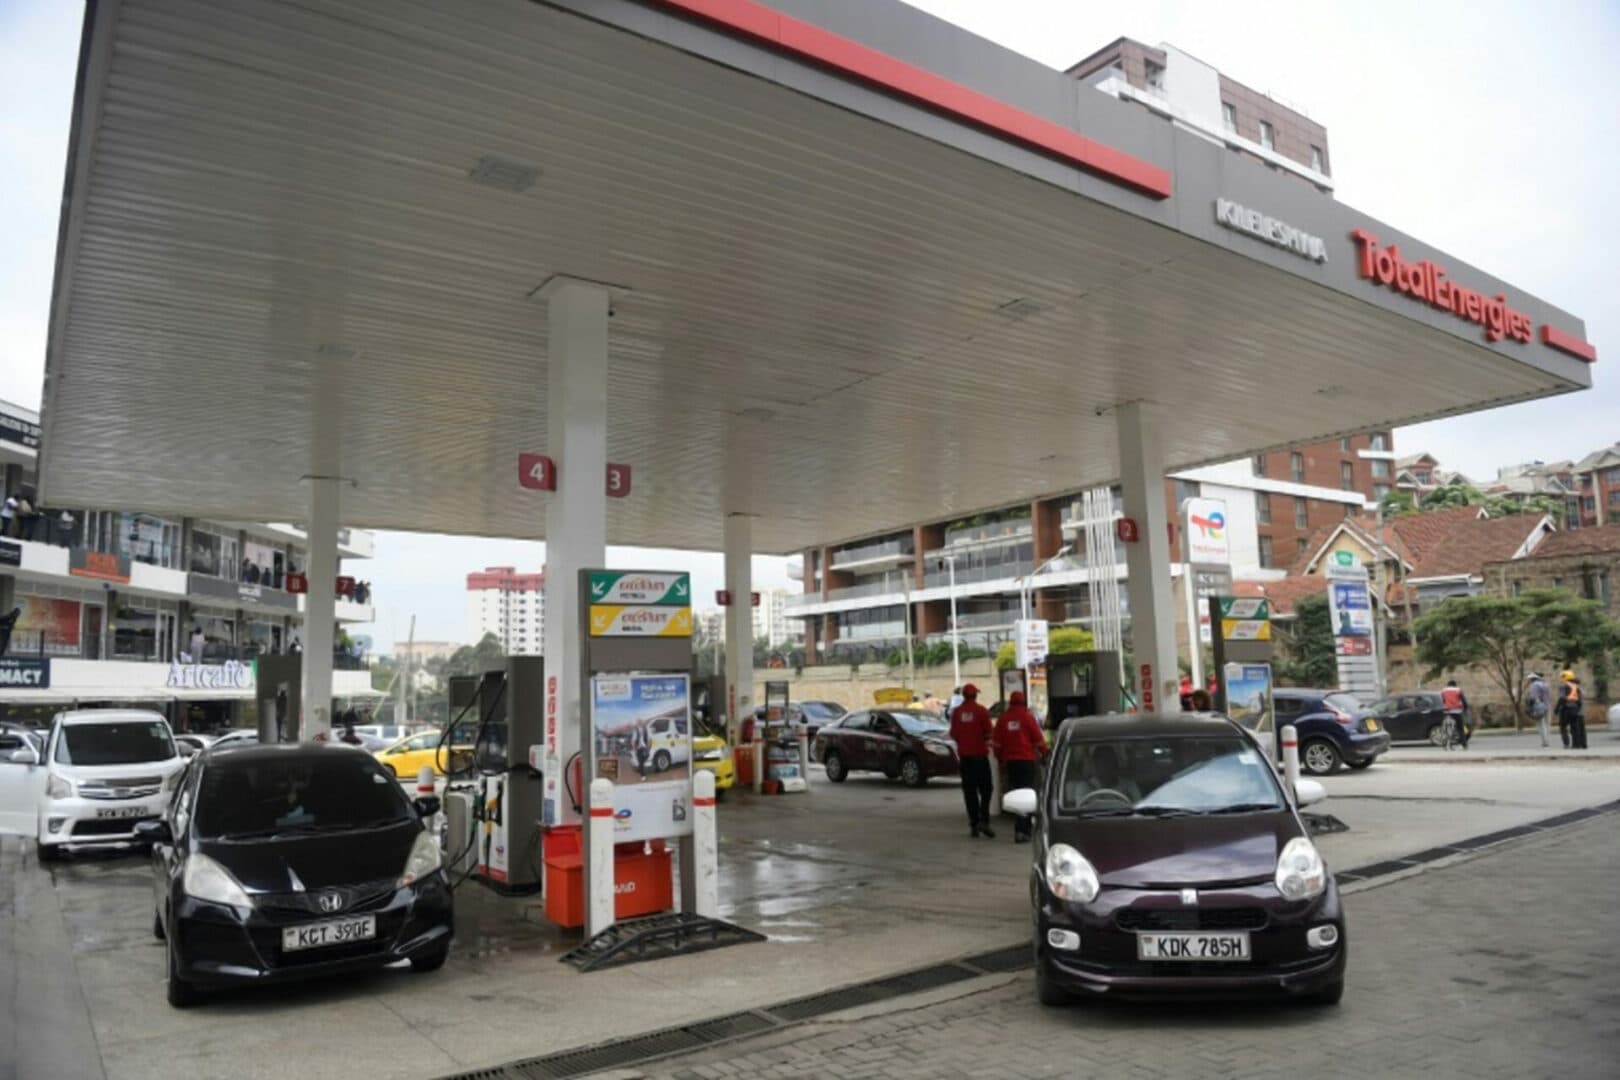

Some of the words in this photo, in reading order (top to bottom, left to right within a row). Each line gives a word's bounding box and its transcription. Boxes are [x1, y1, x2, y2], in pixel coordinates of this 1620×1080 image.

[1351, 229, 1533, 343] TotalEnergies
[530, 462, 544, 481] 4
[608, 470, 621, 490] 3
[334, 920, 371, 941] 390F
[1157, 937, 1191, 958] KDK
[1198, 937, 1243, 957] 785H
